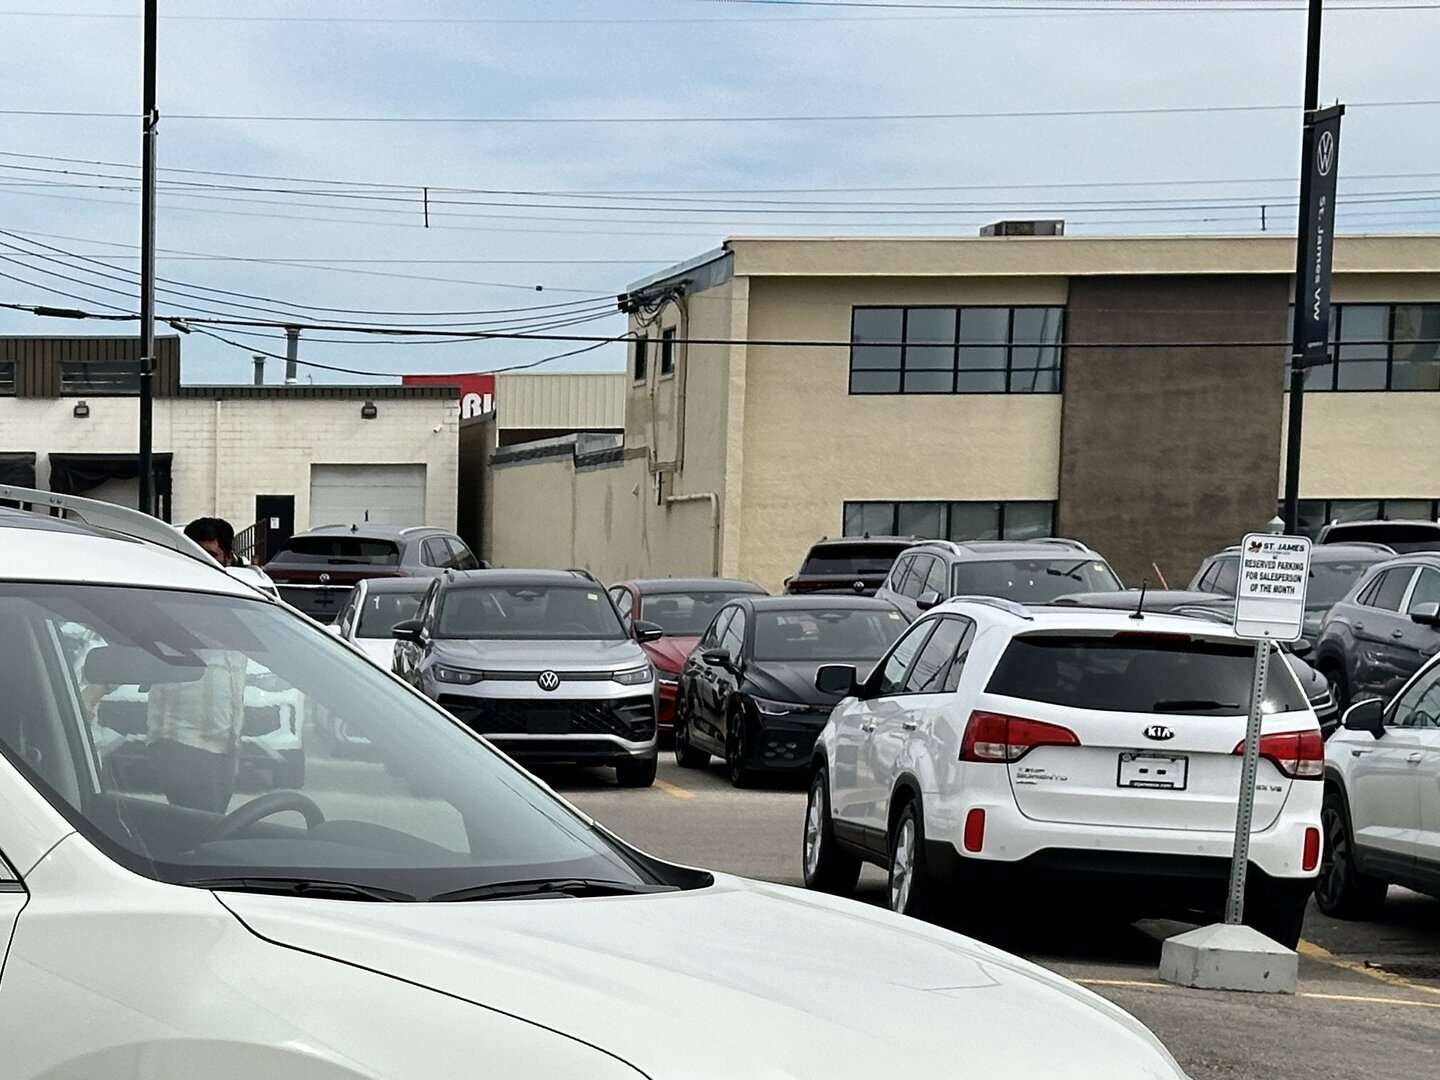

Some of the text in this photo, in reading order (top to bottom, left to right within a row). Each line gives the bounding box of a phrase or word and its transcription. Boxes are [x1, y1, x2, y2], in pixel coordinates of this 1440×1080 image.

[1315, 225, 1324, 284] James
[1313, 287, 1321, 320] VW
[1278, 543, 1305, 552] JAMES
[1245, 559, 1303, 571] RESERVED PARKING
[1246, 571, 1302, 582] FOR SALESPERSON
[1250, 583, 1295, 594] OF THE MONTH
[1146, 726, 1172, 739] KIA
